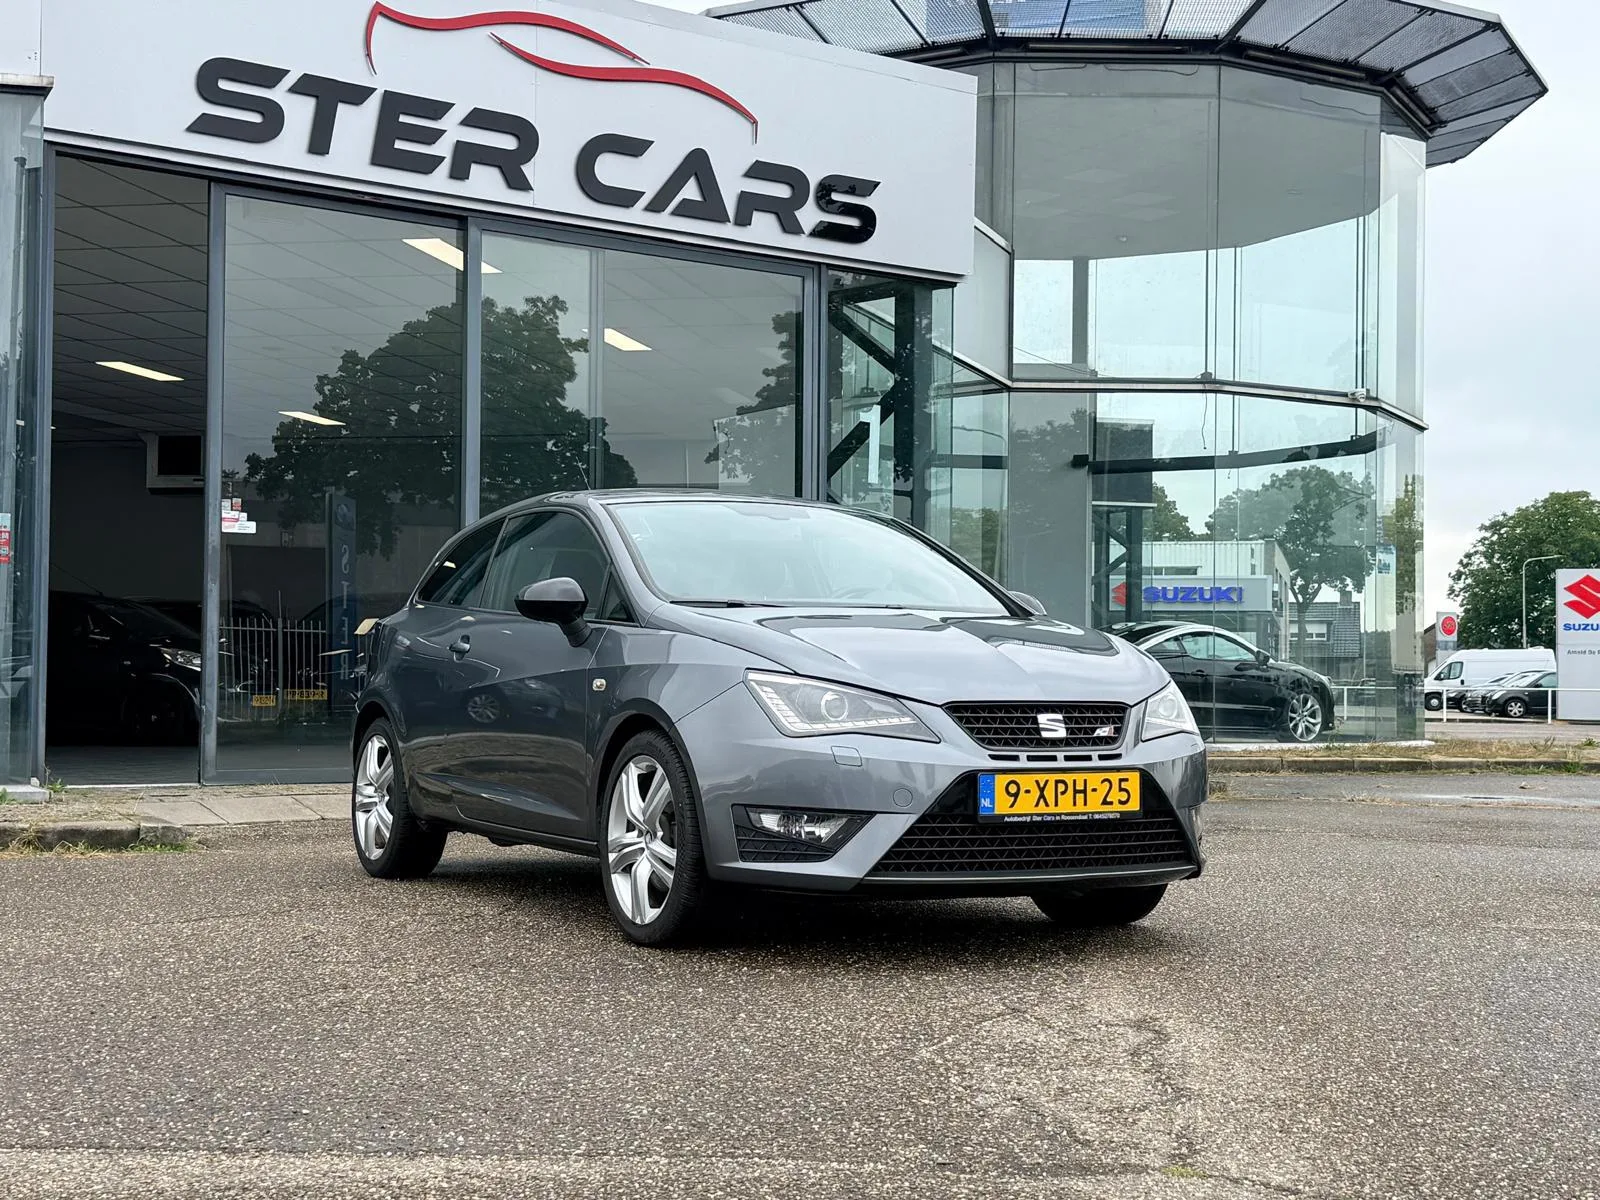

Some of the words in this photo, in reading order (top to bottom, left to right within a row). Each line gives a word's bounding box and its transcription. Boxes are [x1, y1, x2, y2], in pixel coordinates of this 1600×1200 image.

[185, 57, 540, 191] STER
[575, 133, 882, 244] CARS
[1143, 586, 1245, 603] SUZUKI
[1563, 623, 1600, 632] SUZU
[1005, 778, 1131, 808] 9-XPH-25
[981, 798, 993, 808] NL
